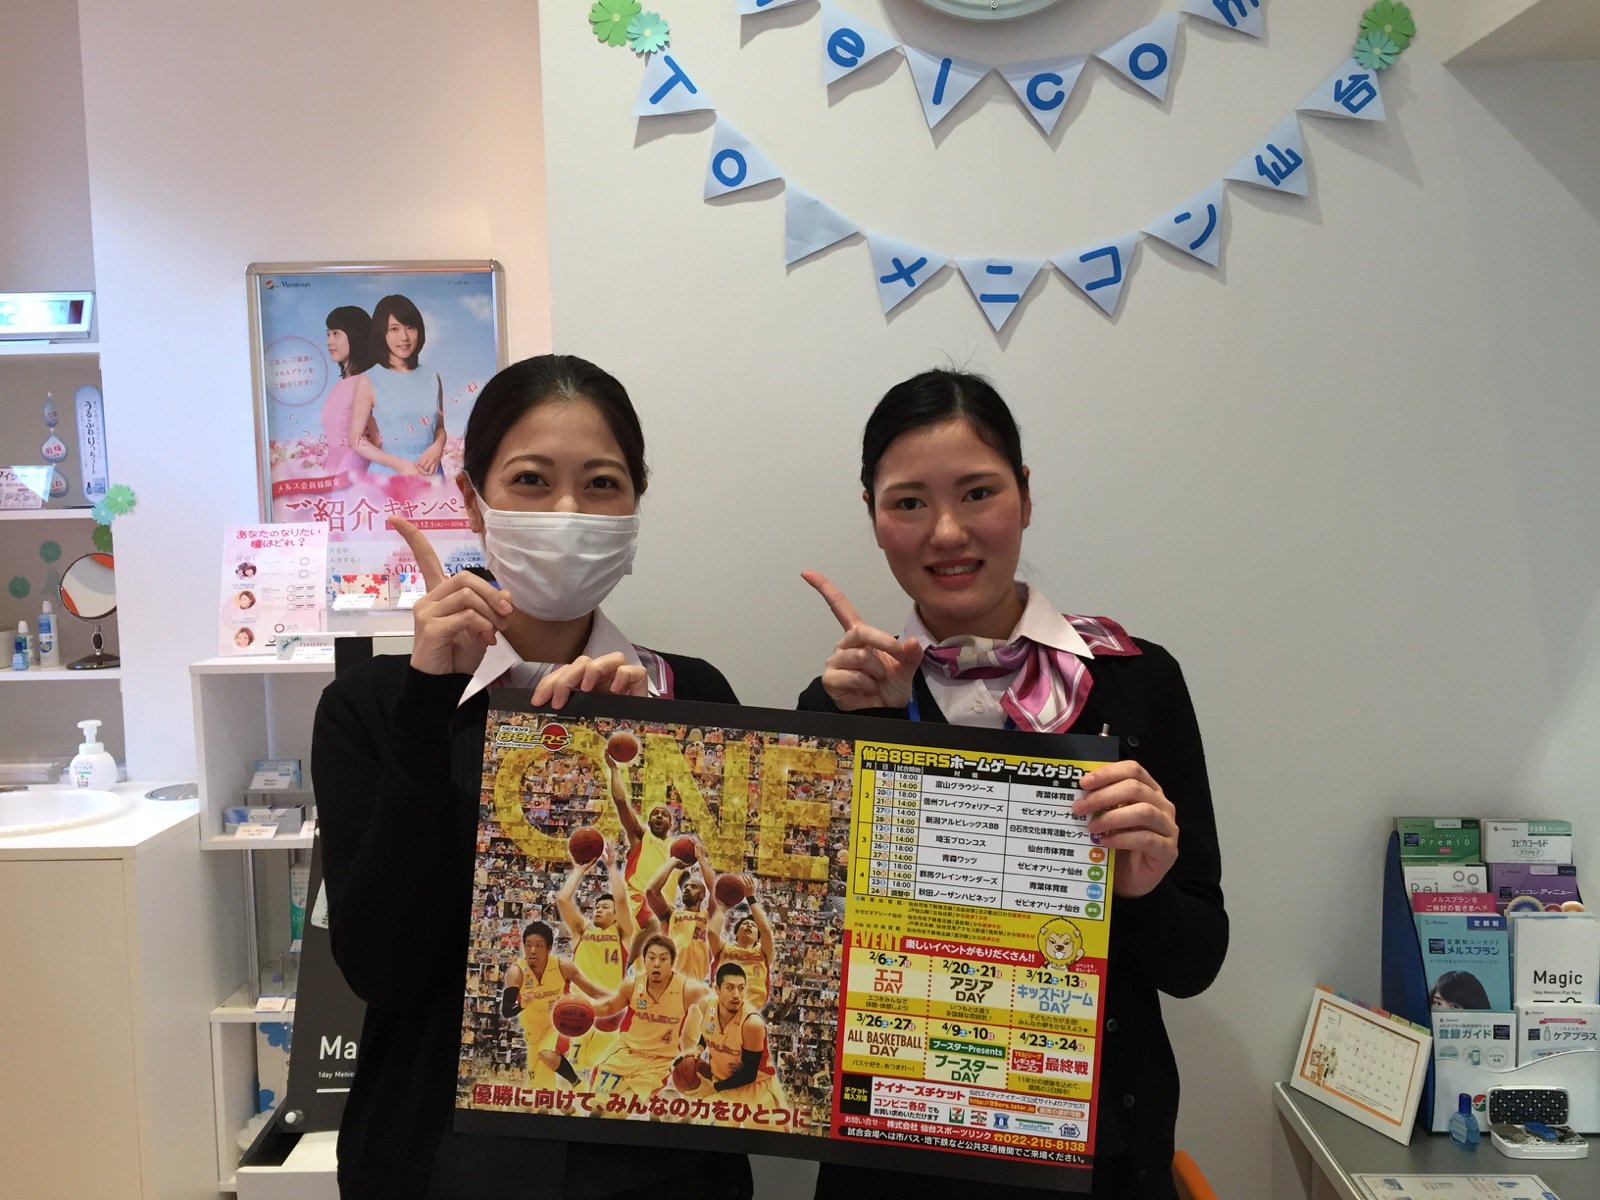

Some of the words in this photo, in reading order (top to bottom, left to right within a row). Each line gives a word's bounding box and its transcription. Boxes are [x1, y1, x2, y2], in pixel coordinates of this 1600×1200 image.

[236, 528, 321, 540] あなたのなりたい
[862, 746, 1089, 780] 仙台89ERSホームゲームスケジュ
[899, 782, 918, 790] 14:00
[935, 780, 994, 793] 富山グラウジーズ
[898, 791, 917, 799] 18:00
[1035, 790, 1075, 801] 青葉体育館
[897, 800, 917, 808] 14:00
[896, 818, 916, 826] 14:00
[935, 835, 987, 847] 埼玉ブロンコス
[895, 844, 914, 853] 18:00
[1027, 844, 1075, 857] 仙台市体育館
[894, 853, 913, 861] 14:00
[941, 853, 978, 865] 青森ワッツ
[893, 863, 913, 871] 18:00
[1017, 861, 1083, 876] ゼビオアリーナ仙台
[893, 871, 912, 879] 14:00
[919, 869, 998, 885] 群馬クレインサンダーズ
[1028, 881, 1069, 893] 青葉体育館
[1014, 898, 1081, 914] ゼビオアリーナ仙台
[852, 930, 901, 951] EVENT
[603, 947, 620, 965] 14
[1446, 946, 1500, 956] メルスプラン
[874, 968, 904, 984] エコ
[1533, 970, 1583, 989] Magic
[873, 981, 904, 994] DAY
[950, 975, 994, 993] アジア
[955, 990, 986, 1004] DAY
[1016, 984, 1094, 1007] キッズドリーム
[1038, 1000, 1070, 1014] DAY
[660, 1028, 674, 1045] 4
[847, 1029, 865, 1043] ALL
[866, 1030, 923, 1049] BASKETBALL
[1438, 1028, 1493, 1040] 登録ガイド
[1553, 1031, 1598, 1041] ケアプラス
[869, 1044, 900, 1058] DAY
[932, 1040, 1004, 1057] ブースターPresents
[934, 1055, 999, 1073] ブースター
[1045, 1057, 1089, 1076] 最終戦
[950, 1070, 981, 1084] DAY
[844, 1086, 869, 1095] チケット
[874, 1081, 966, 1101] ナイナーズチケット
[471, 1083, 813, 1129] 優勝に向けて、みんなの力をひとつに
[873, 1107, 940, 1121] お買い求めいただけます
[1019, 1122, 1051, 1132] FamilyMart
[886, 1120, 919, 1131] 株式会社
[921, 1123, 992, 1140] 仙台スポーツリンク
[1003, 1134, 1086, 1152] 022-215-8138
